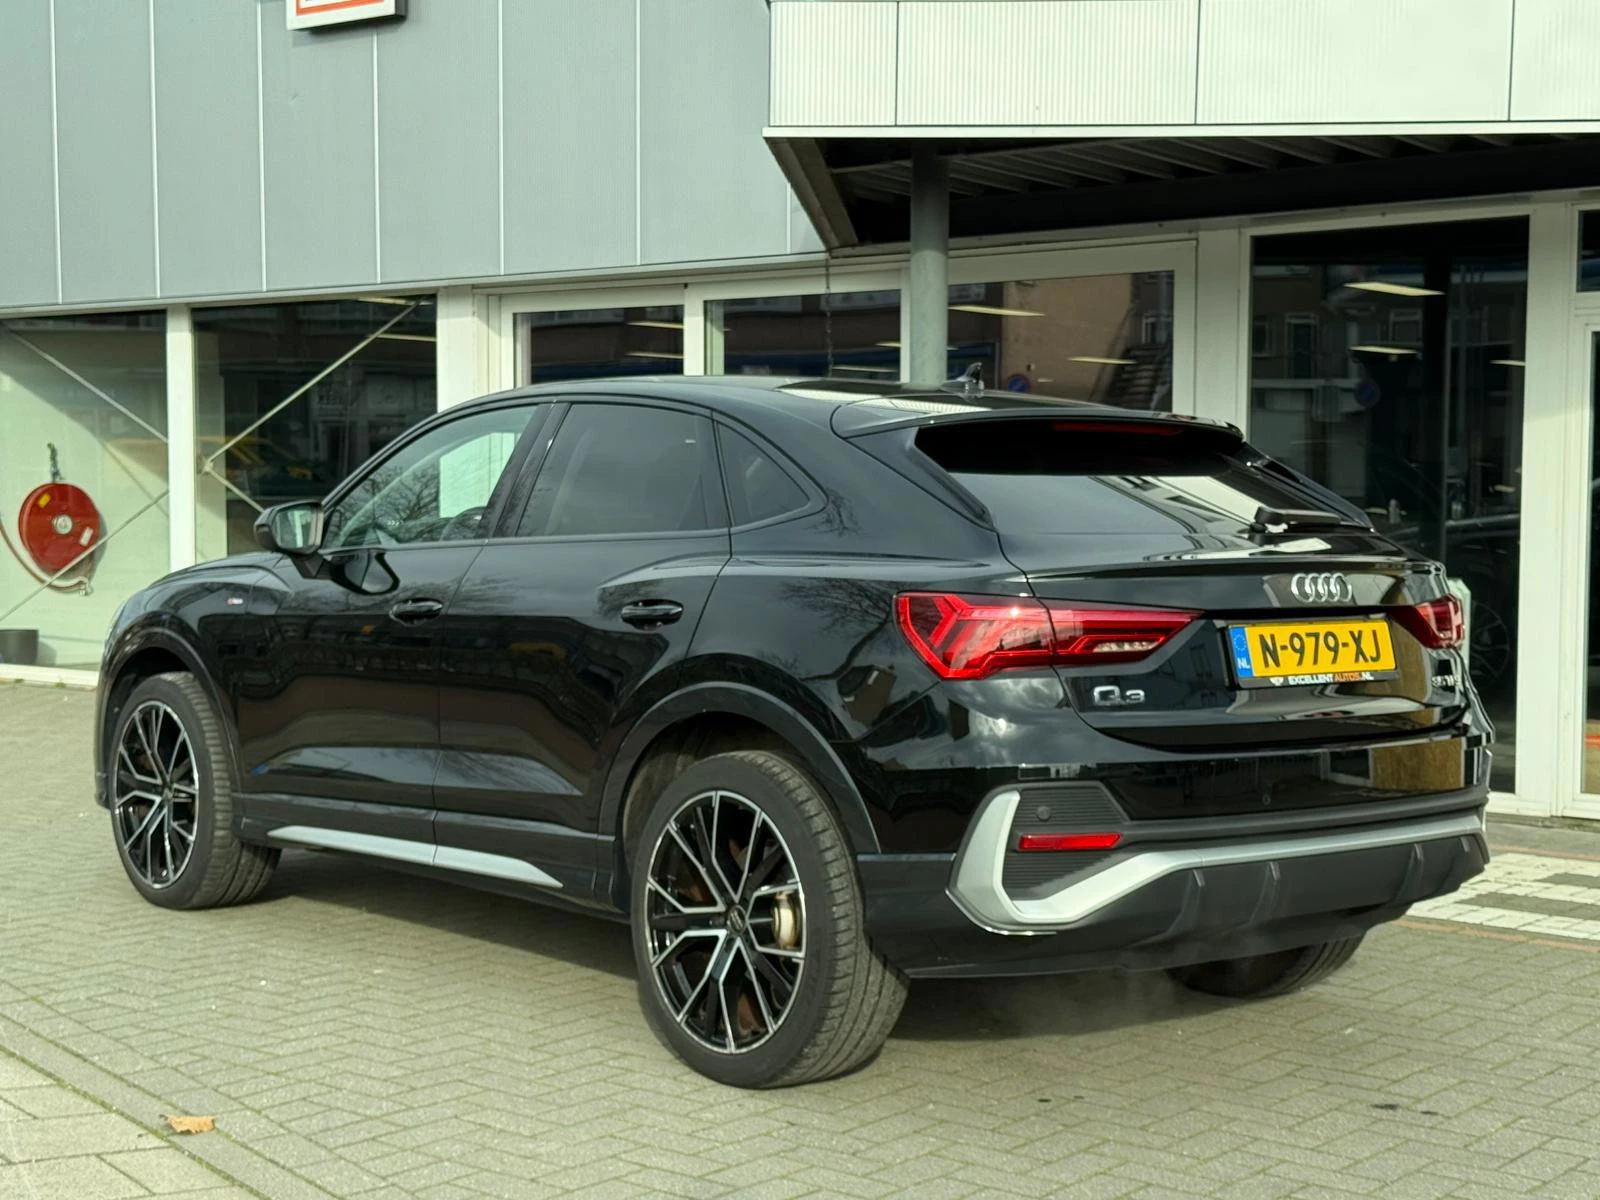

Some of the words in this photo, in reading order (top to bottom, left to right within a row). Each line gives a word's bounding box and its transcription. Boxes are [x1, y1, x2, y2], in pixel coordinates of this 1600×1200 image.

[1259, 630, 1381, 668] N-979-XJ
[1237, 658, 1250, 669] NL
[1093, 685, 1145, 706] Q3
